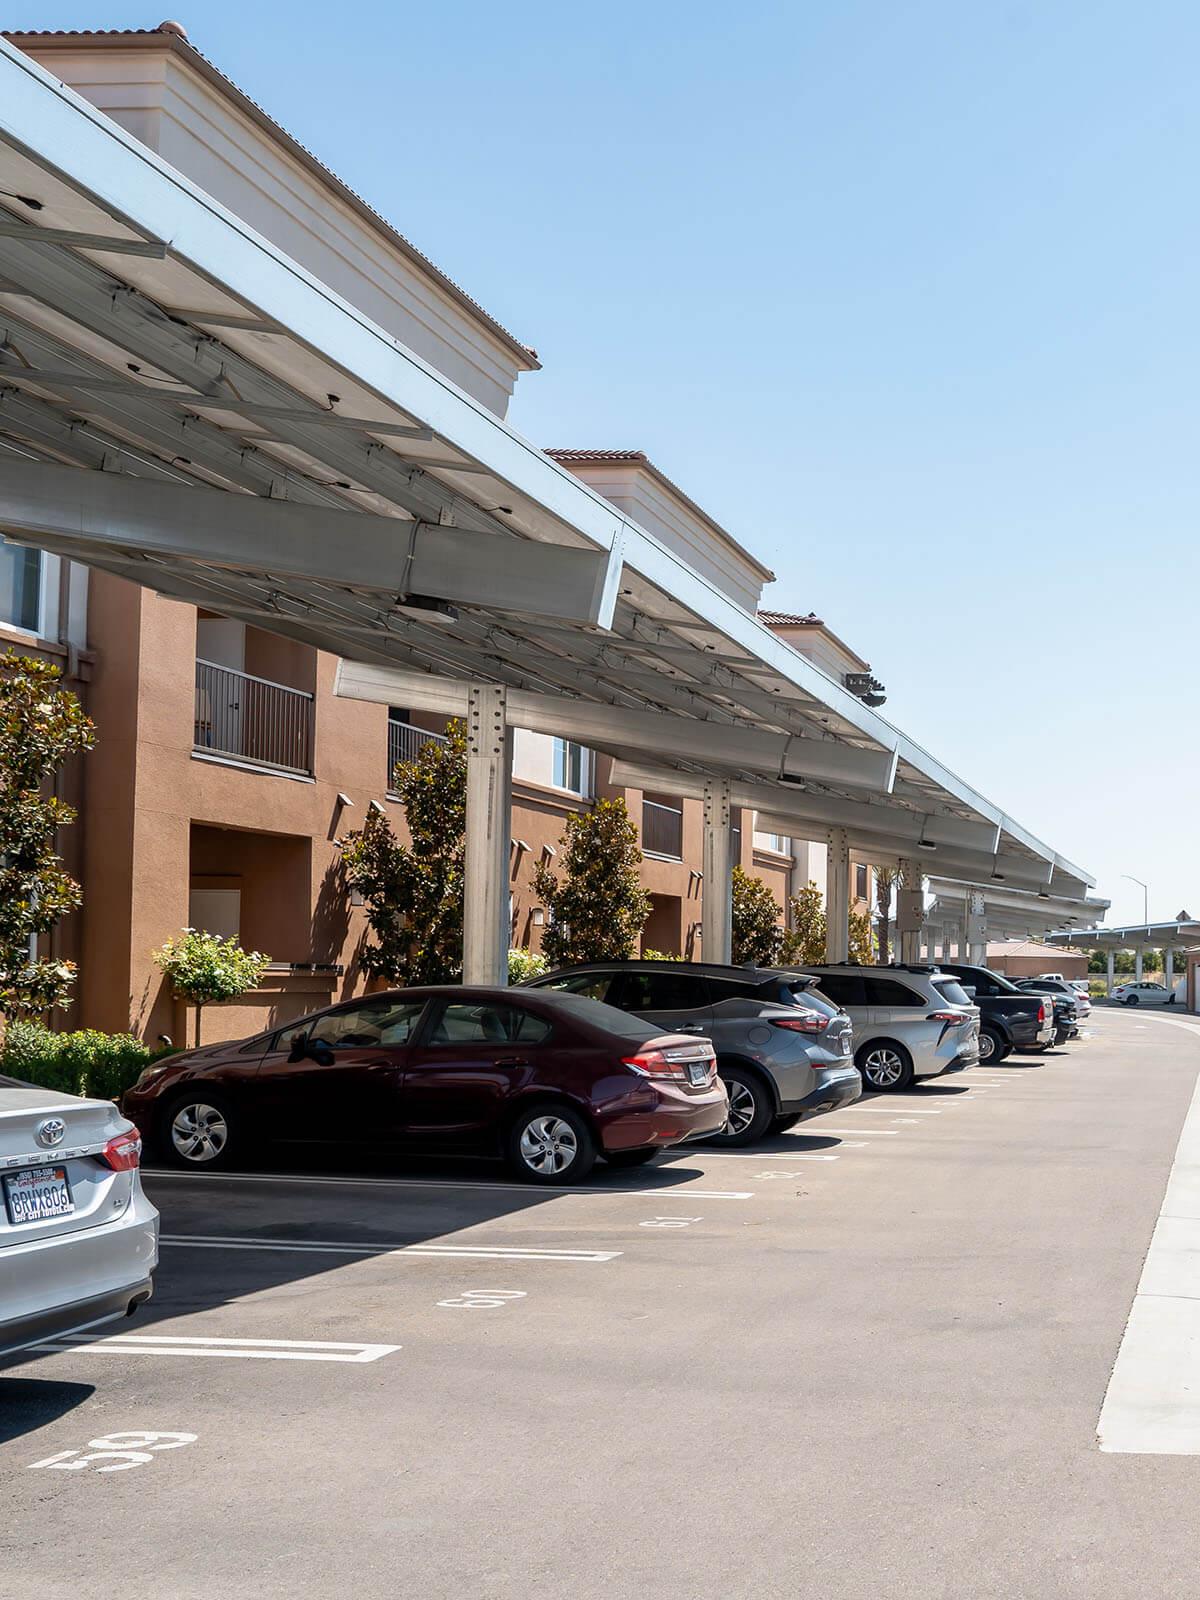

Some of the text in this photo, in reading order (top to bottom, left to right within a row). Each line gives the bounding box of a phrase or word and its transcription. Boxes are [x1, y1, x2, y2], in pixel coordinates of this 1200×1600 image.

[12, 1184, 68, 1214] 8RWX806
[637, 1216, 705, 1228] 61
[435, 1289, 528, 1309] 60
[26, 1431, 199, 1472] 59
